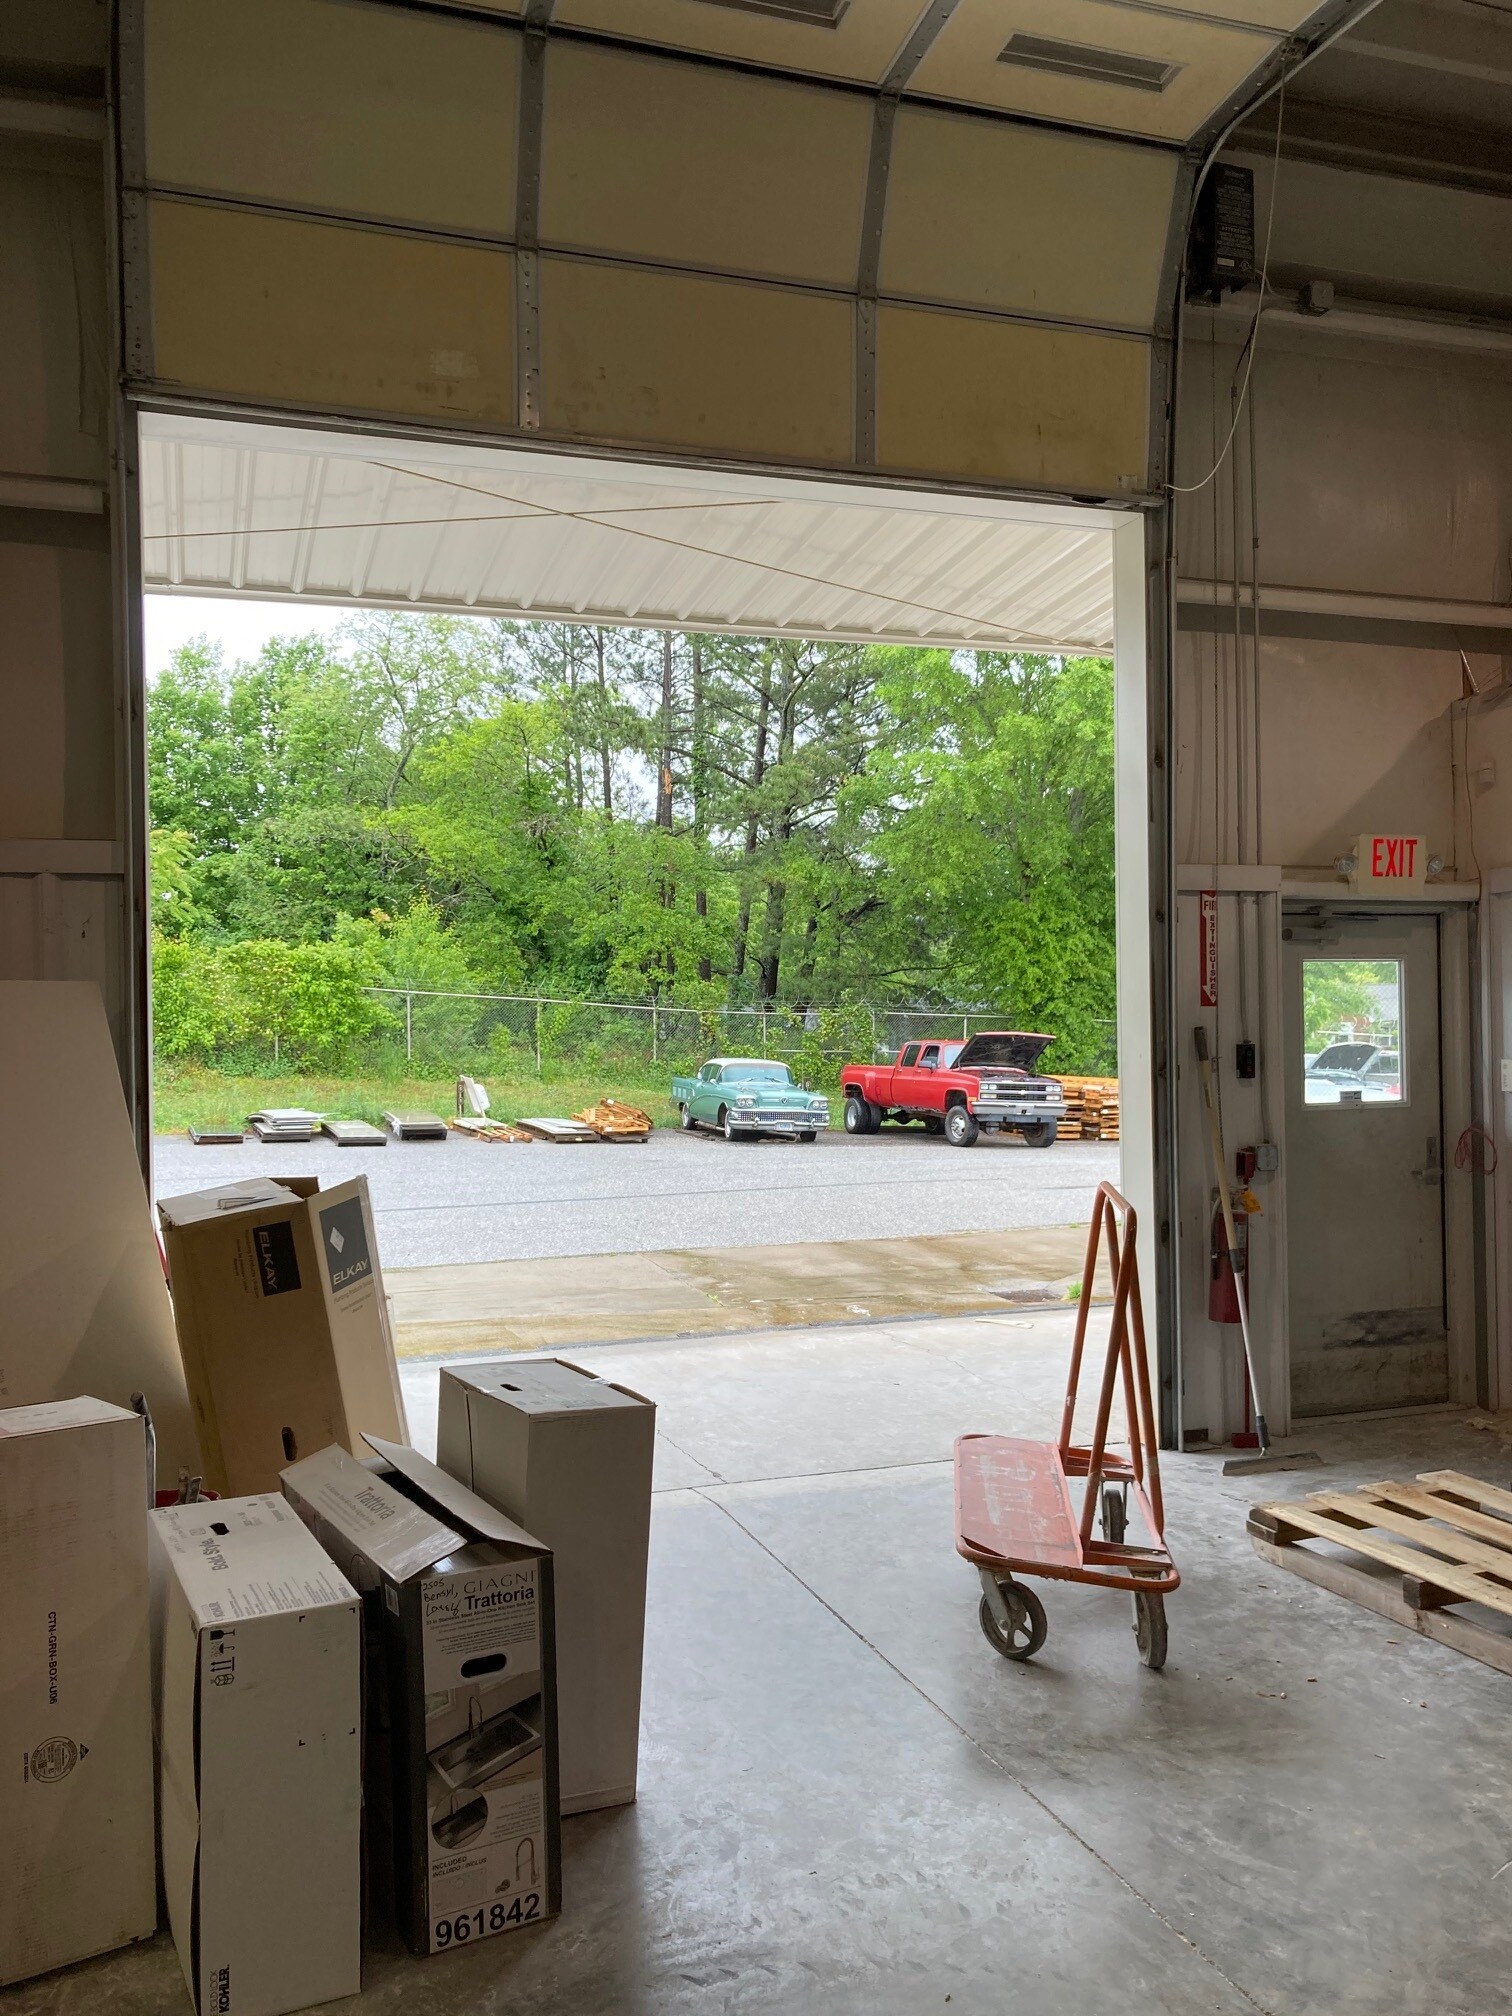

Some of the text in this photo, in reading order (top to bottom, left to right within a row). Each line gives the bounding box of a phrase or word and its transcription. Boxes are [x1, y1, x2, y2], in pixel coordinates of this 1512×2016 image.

[1372, 838, 1418, 878] EXIT
[1203, 900, 1217, 911] FIR
[1209, 914, 1217, 997] EXTINGUISHER
[258, 1231, 278, 1291] ELKAY
[332, 1258, 369, 1286] ELKAY
[354, 1486, 396, 1521] Trattoria
[199, 1537, 229, 1571] Bold Style
[463, 1570, 536, 1594] GIAGNI
[464, 1586, 535, 1611] Trattoria
[47, 1611, 58, 1705] CTN-GRN-BOX-U06
[432, 1856, 468, 1872] INCLUDED
[435, 1892, 540, 1948] 961842
